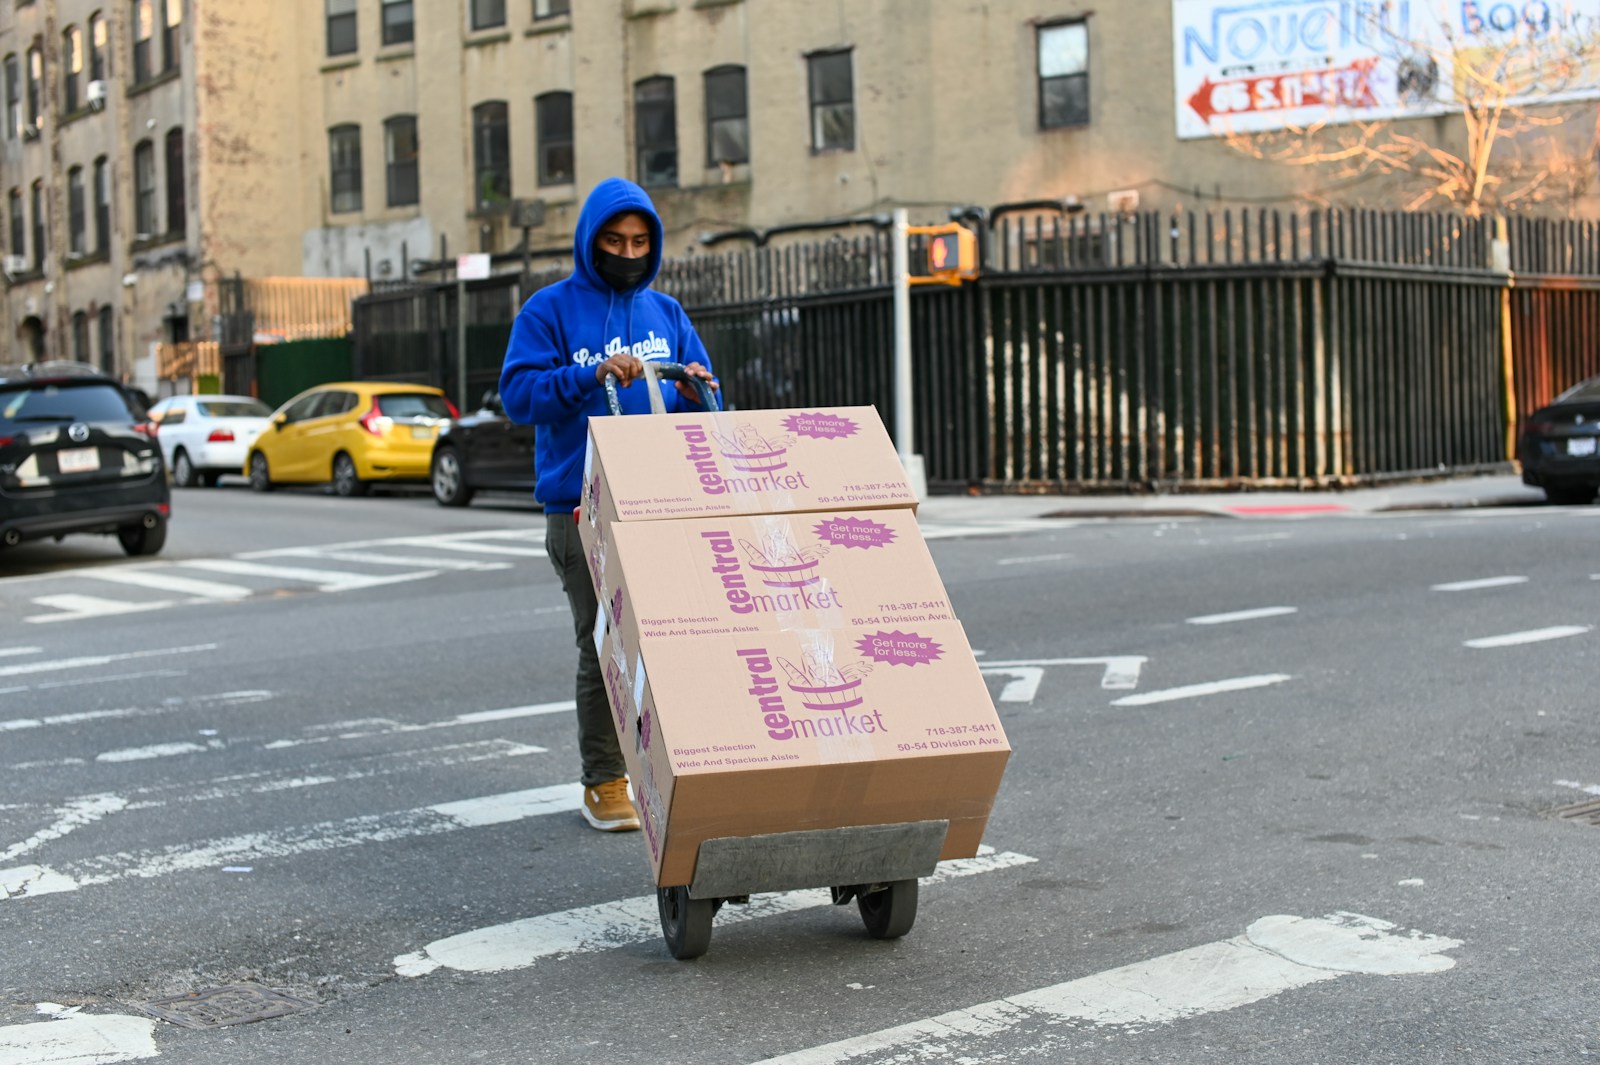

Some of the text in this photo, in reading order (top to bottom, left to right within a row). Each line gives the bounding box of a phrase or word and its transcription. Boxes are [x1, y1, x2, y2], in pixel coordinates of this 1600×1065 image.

[573, 347, 603, 368] Los
[796, 418, 816, 426] Get
[797, 424, 847, 434] for less...
[675, 424, 726, 495] central
[723, 471, 810, 494] market
[843, 482, 908, 492] 718-387-5411
[653, 496, 693, 504] Selection
[818, 491, 913, 503] 50-54 Division Ave.
[664, 505, 704, 514] Spacious
[829, 523, 881, 534] Get more
[830, 531, 882, 542] for less...
[701, 530, 754, 614] central
[751, 586, 843, 613] market
[878, 601, 945, 612] 718-387-5411
[641, 616, 719, 626] Biggest Selection
[851, 613, 951, 626] 50-54 Division Ave.
[668, 629, 687, 637] And
[689, 626, 731, 636] Spacious
[872, 638, 927, 649] Get more
[874, 647, 928, 658] for less...
[736, 648, 794, 741] central
[791, 709, 889, 739] market
[925, 723, 996, 736] 718-387-5411
[673, 744, 756, 756] Biggest Selection
[897, 742, 928, 751] 50-54
[930, 739, 976, 749] Division
[676, 761, 700, 769] Wide
[725, 756, 769, 766] Spacious
